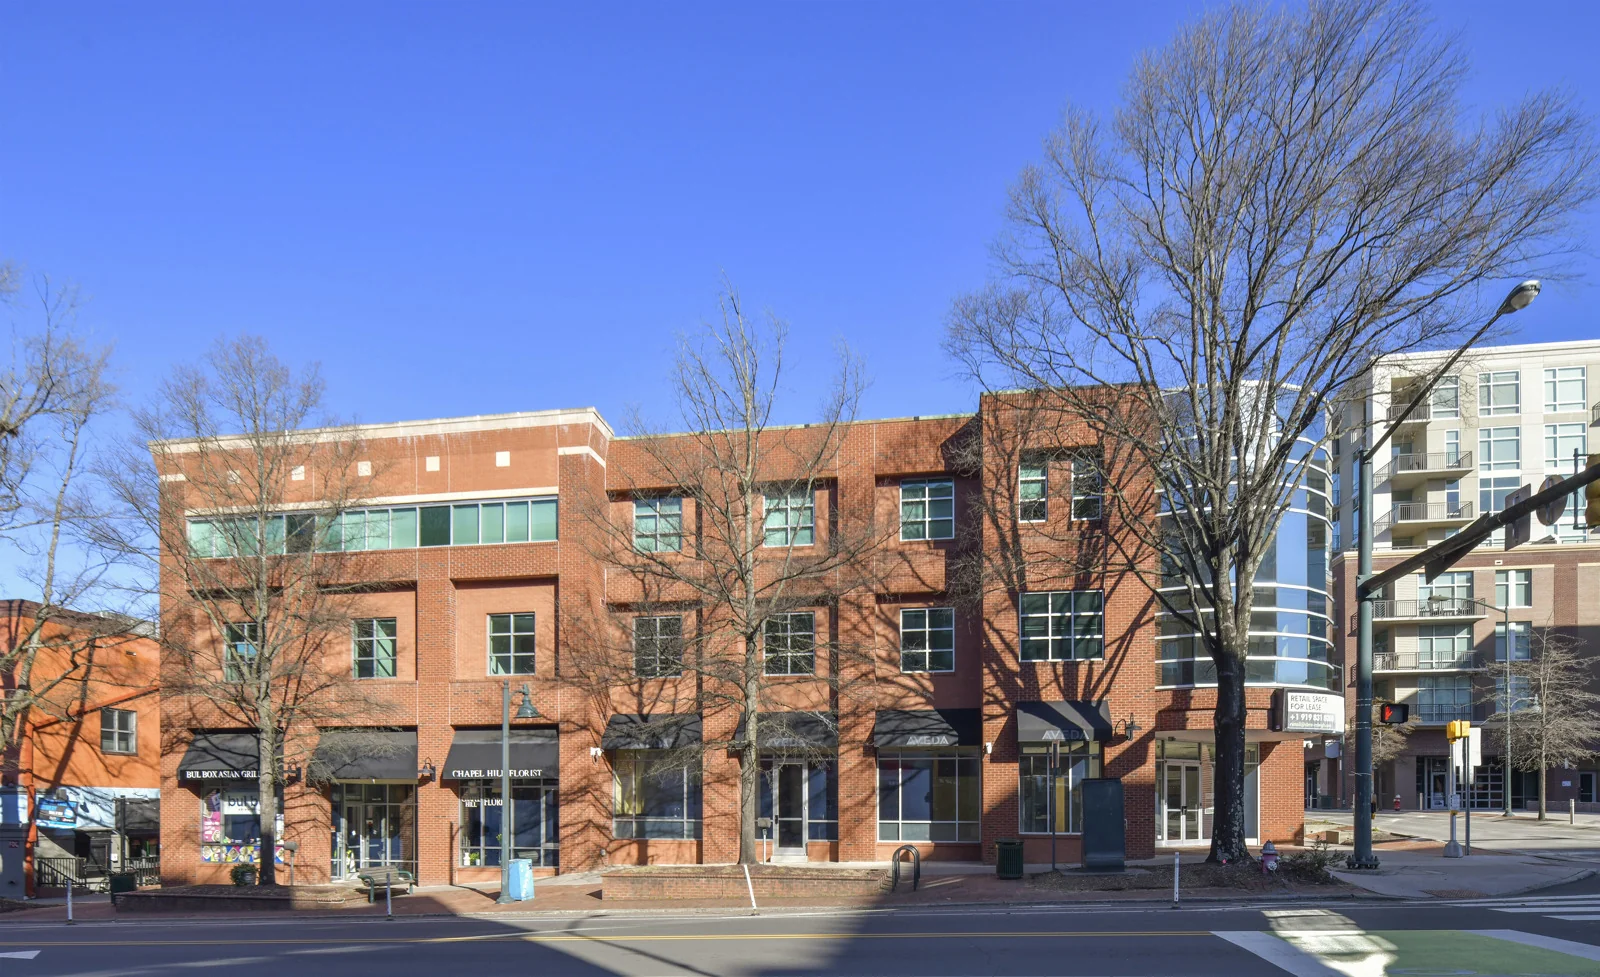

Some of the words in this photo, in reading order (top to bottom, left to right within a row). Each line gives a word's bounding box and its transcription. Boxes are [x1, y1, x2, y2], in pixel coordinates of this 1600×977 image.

[1312, 695, 1328, 703] SPACE
[1305, 703, 1322, 711] LEASE
[1042, 729, 1090, 740] AVEDA
[906, 735, 950, 745] AVEDA
[186, 770, 202, 779] BUL
[202, 770, 218, 779] BOX
[218, 770, 240, 778] ASIAN
[452, 769, 485, 778] CHAPEL
[509, 769, 543, 777] FLORIST
[228, 795, 248, 807] bul
